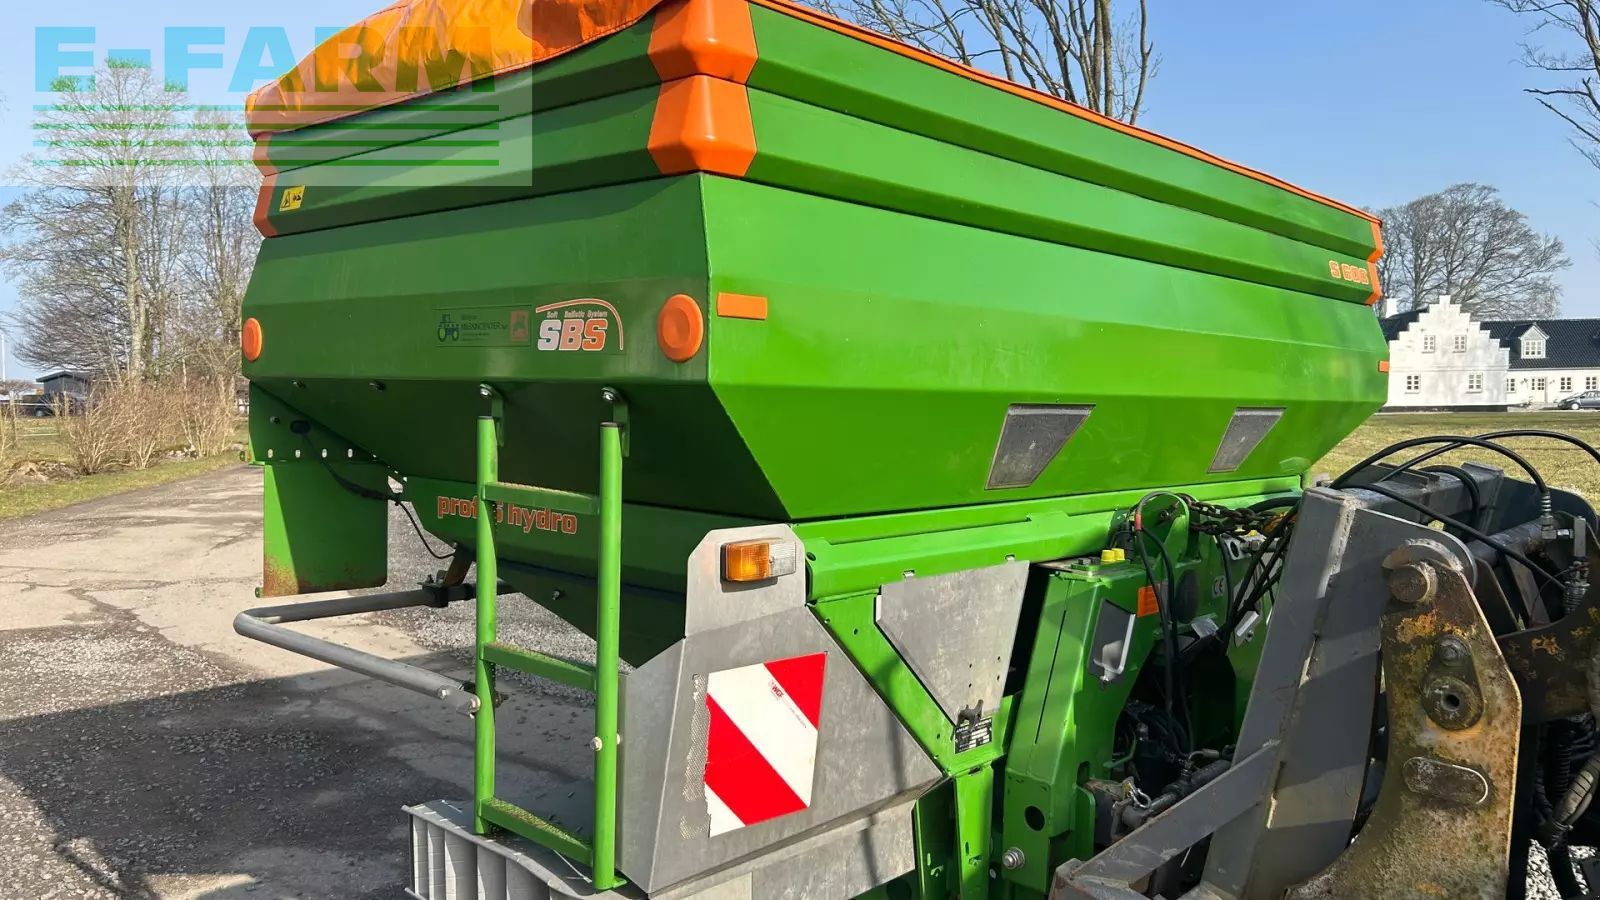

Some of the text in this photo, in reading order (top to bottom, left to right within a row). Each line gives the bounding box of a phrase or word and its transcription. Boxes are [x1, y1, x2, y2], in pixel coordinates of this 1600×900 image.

[1329, 260, 1341, 279] S
[537, 318, 608, 351] SBS
[507, 502, 577, 535] hydro
